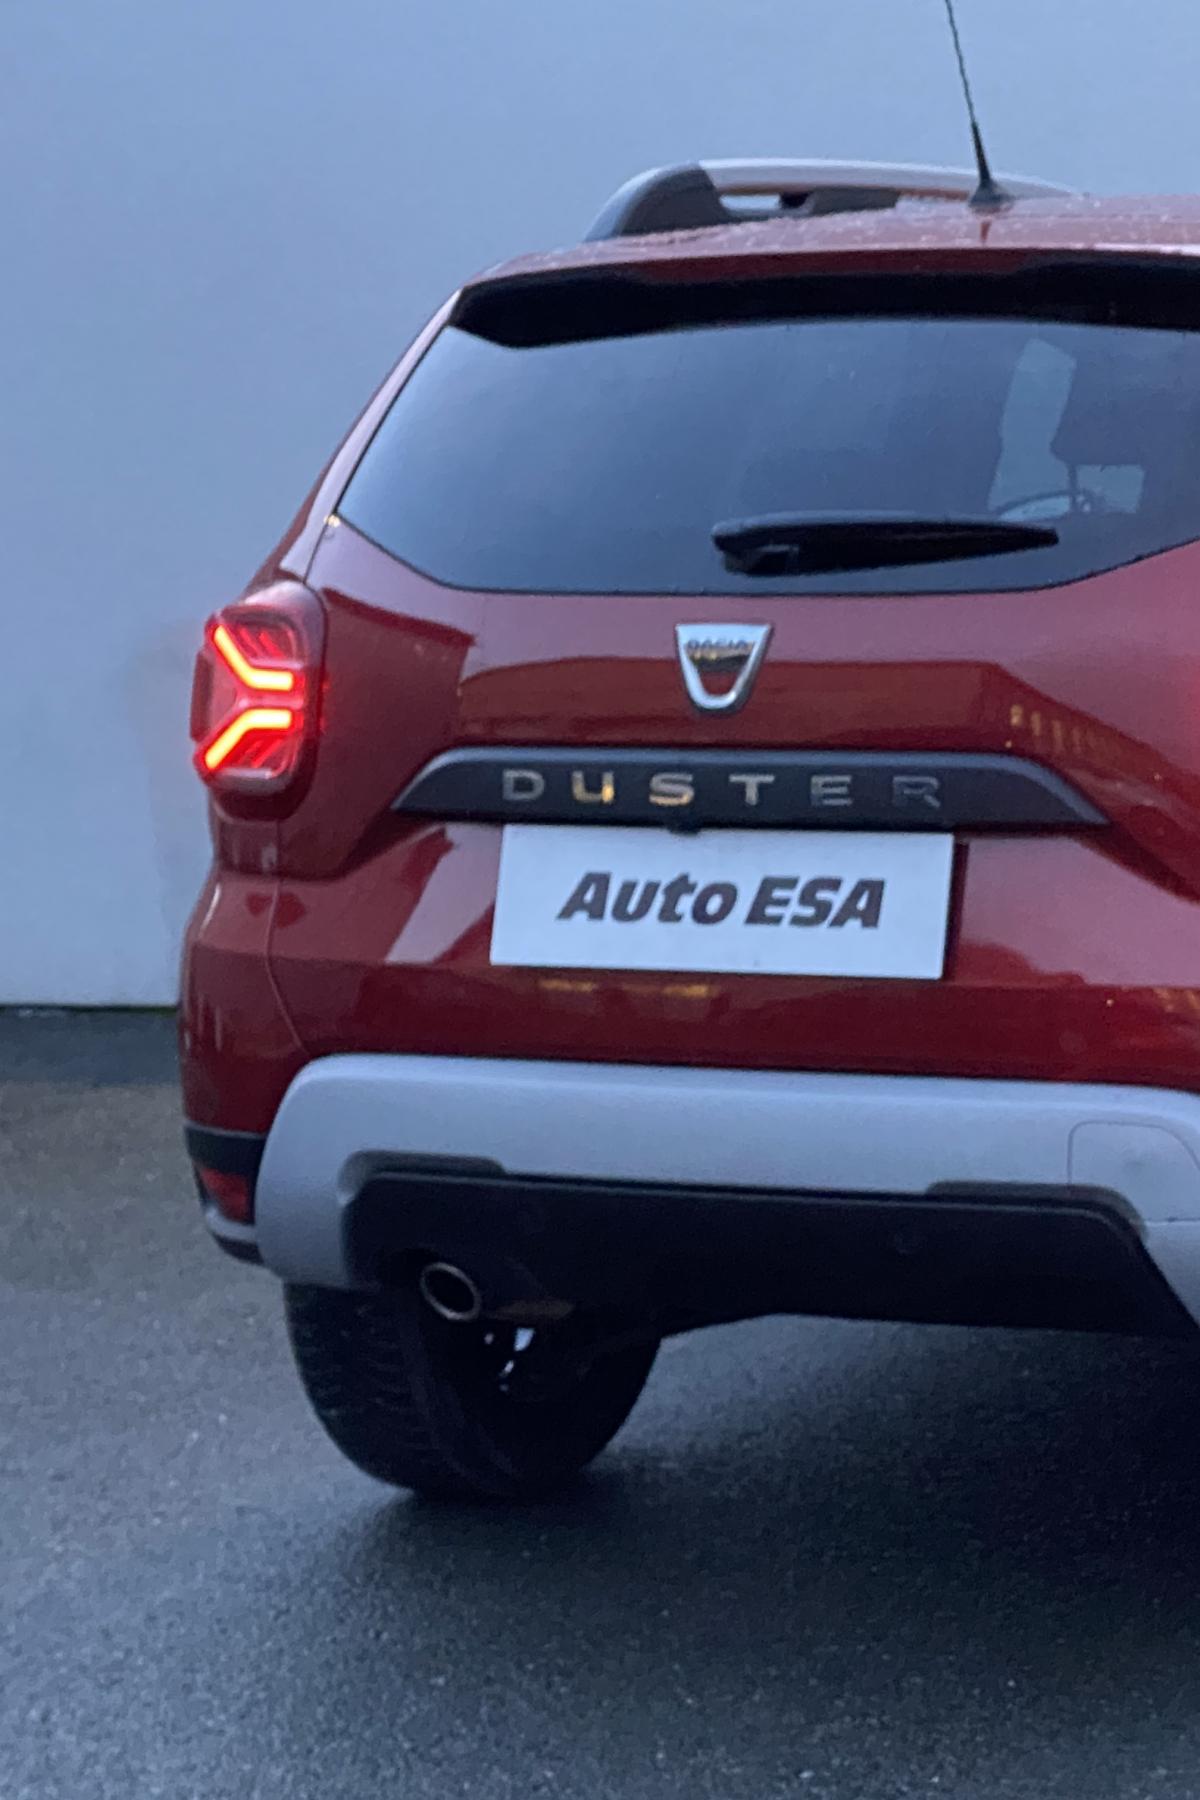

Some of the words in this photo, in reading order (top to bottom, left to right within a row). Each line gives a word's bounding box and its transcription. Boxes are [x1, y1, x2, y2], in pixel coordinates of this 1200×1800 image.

[503, 769, 941, 808] DUSTER
[556, 872, 739, 926] Auto
[744, 876, 886, 929] ESA
